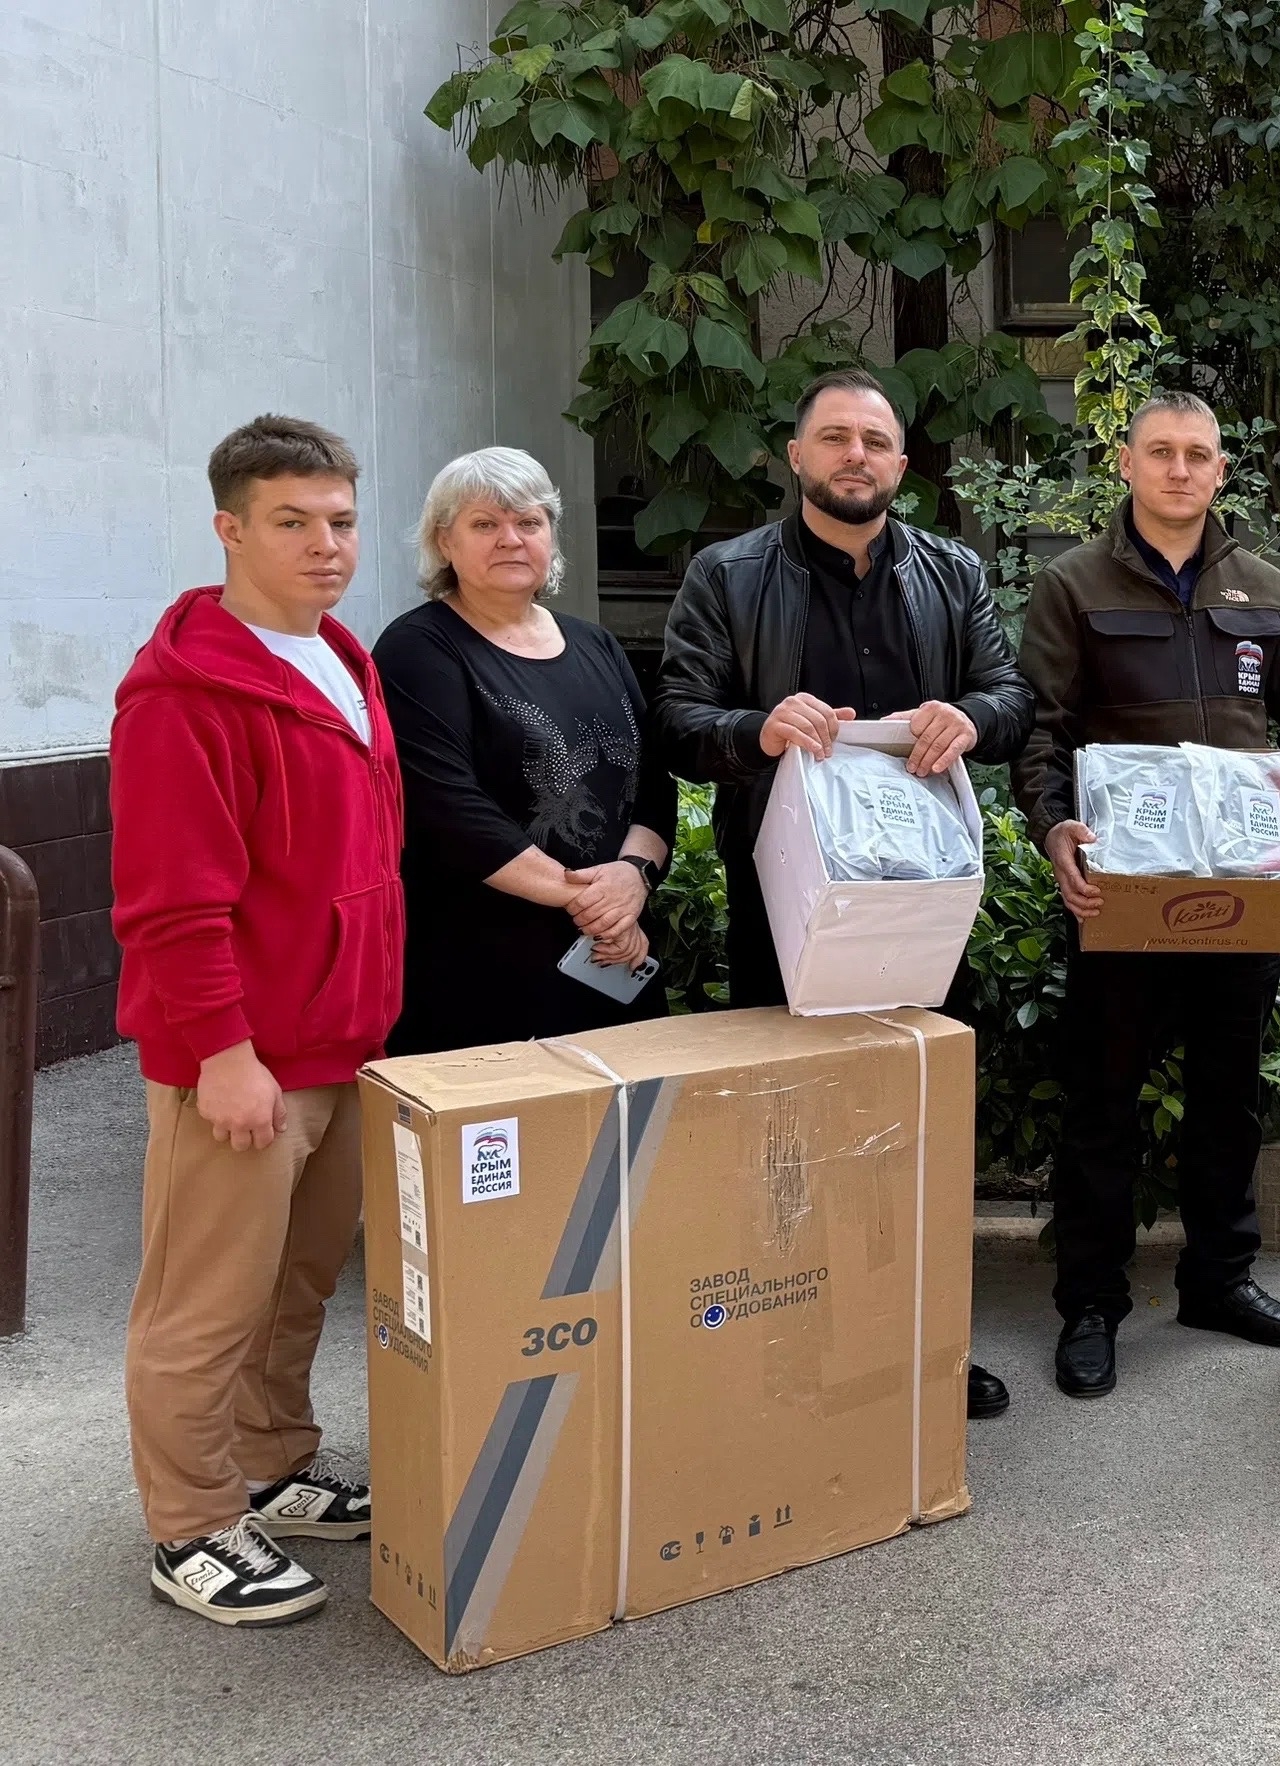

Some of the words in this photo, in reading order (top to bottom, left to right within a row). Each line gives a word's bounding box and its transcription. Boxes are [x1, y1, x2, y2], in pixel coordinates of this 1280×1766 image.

[1238, 671, 1261, 682] КРЫМ
[880, 799, 912, 811] КРЫМ
[881, 806, 914, 817] ЕДИНАЯ
[1136, 807, 1167, 817] КРЫМ
[883, 813, 915, 824] РОССИЯ
[1134, 814, 1166, 823] ЕДИНАЯ
[1249, 812, 1277, 824] КРЫМ
[1133, 820, 1165, 830] РОССИЯ
[1250, 819, 1279, 831] ЕДИНАЯ
[1251, 826, 1279, 838] РОССИЯ
[1148, 936, 1248, 947] www.kontirus.ru
[471, 1157, 512, 1174] КРЫМ
[471, 1169, 512, 1186] ЕДИНАЯ
[471, 1180, 513, 1196] РОССИЯ
[690, 1267, 750, 1293] ЗАВОД
[690, 1267, 829, 1311] СПЕЦИАЛЬНОГО
[372, 1288, 400, 1317] ЗАВОД
[690, 1286, 818, 1328] ОУДОВАНИЯ
